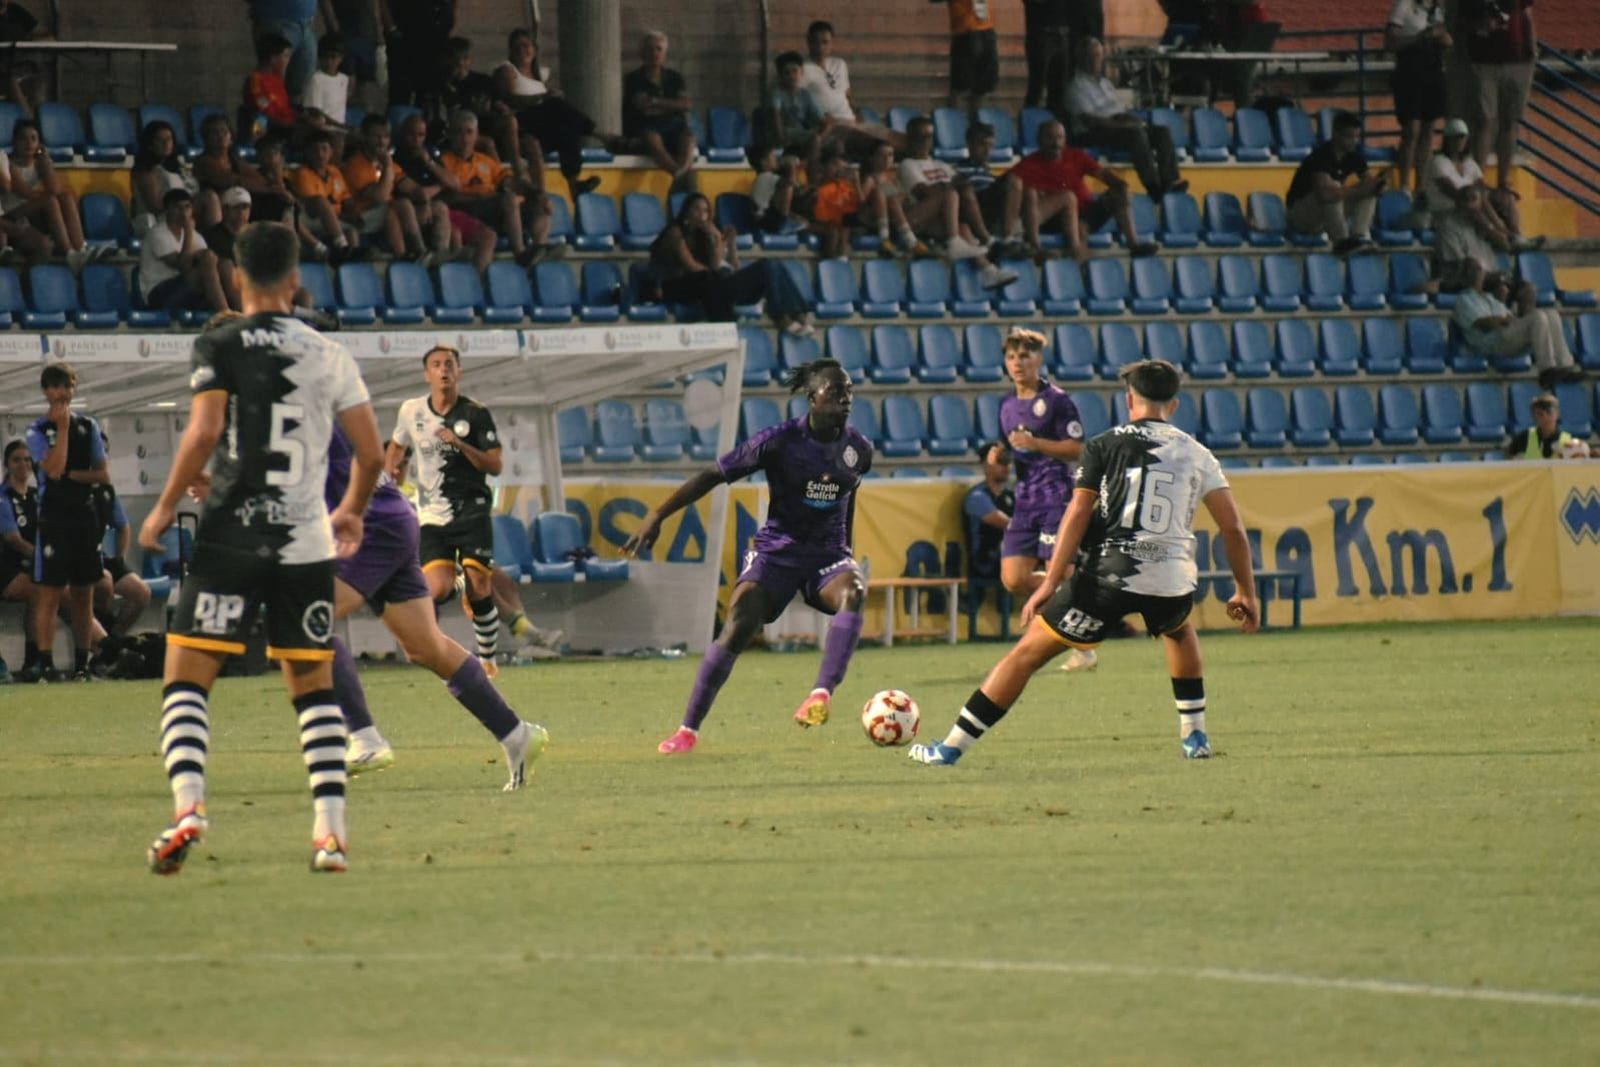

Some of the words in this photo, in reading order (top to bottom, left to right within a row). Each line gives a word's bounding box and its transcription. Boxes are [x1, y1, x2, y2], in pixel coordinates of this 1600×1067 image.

[265, 402, 304, 487] 5
[805, 479, 840, 493] Estrella
[805, 489, 837, 501] Galicia
[1120, 466, 1176, 536] 16
